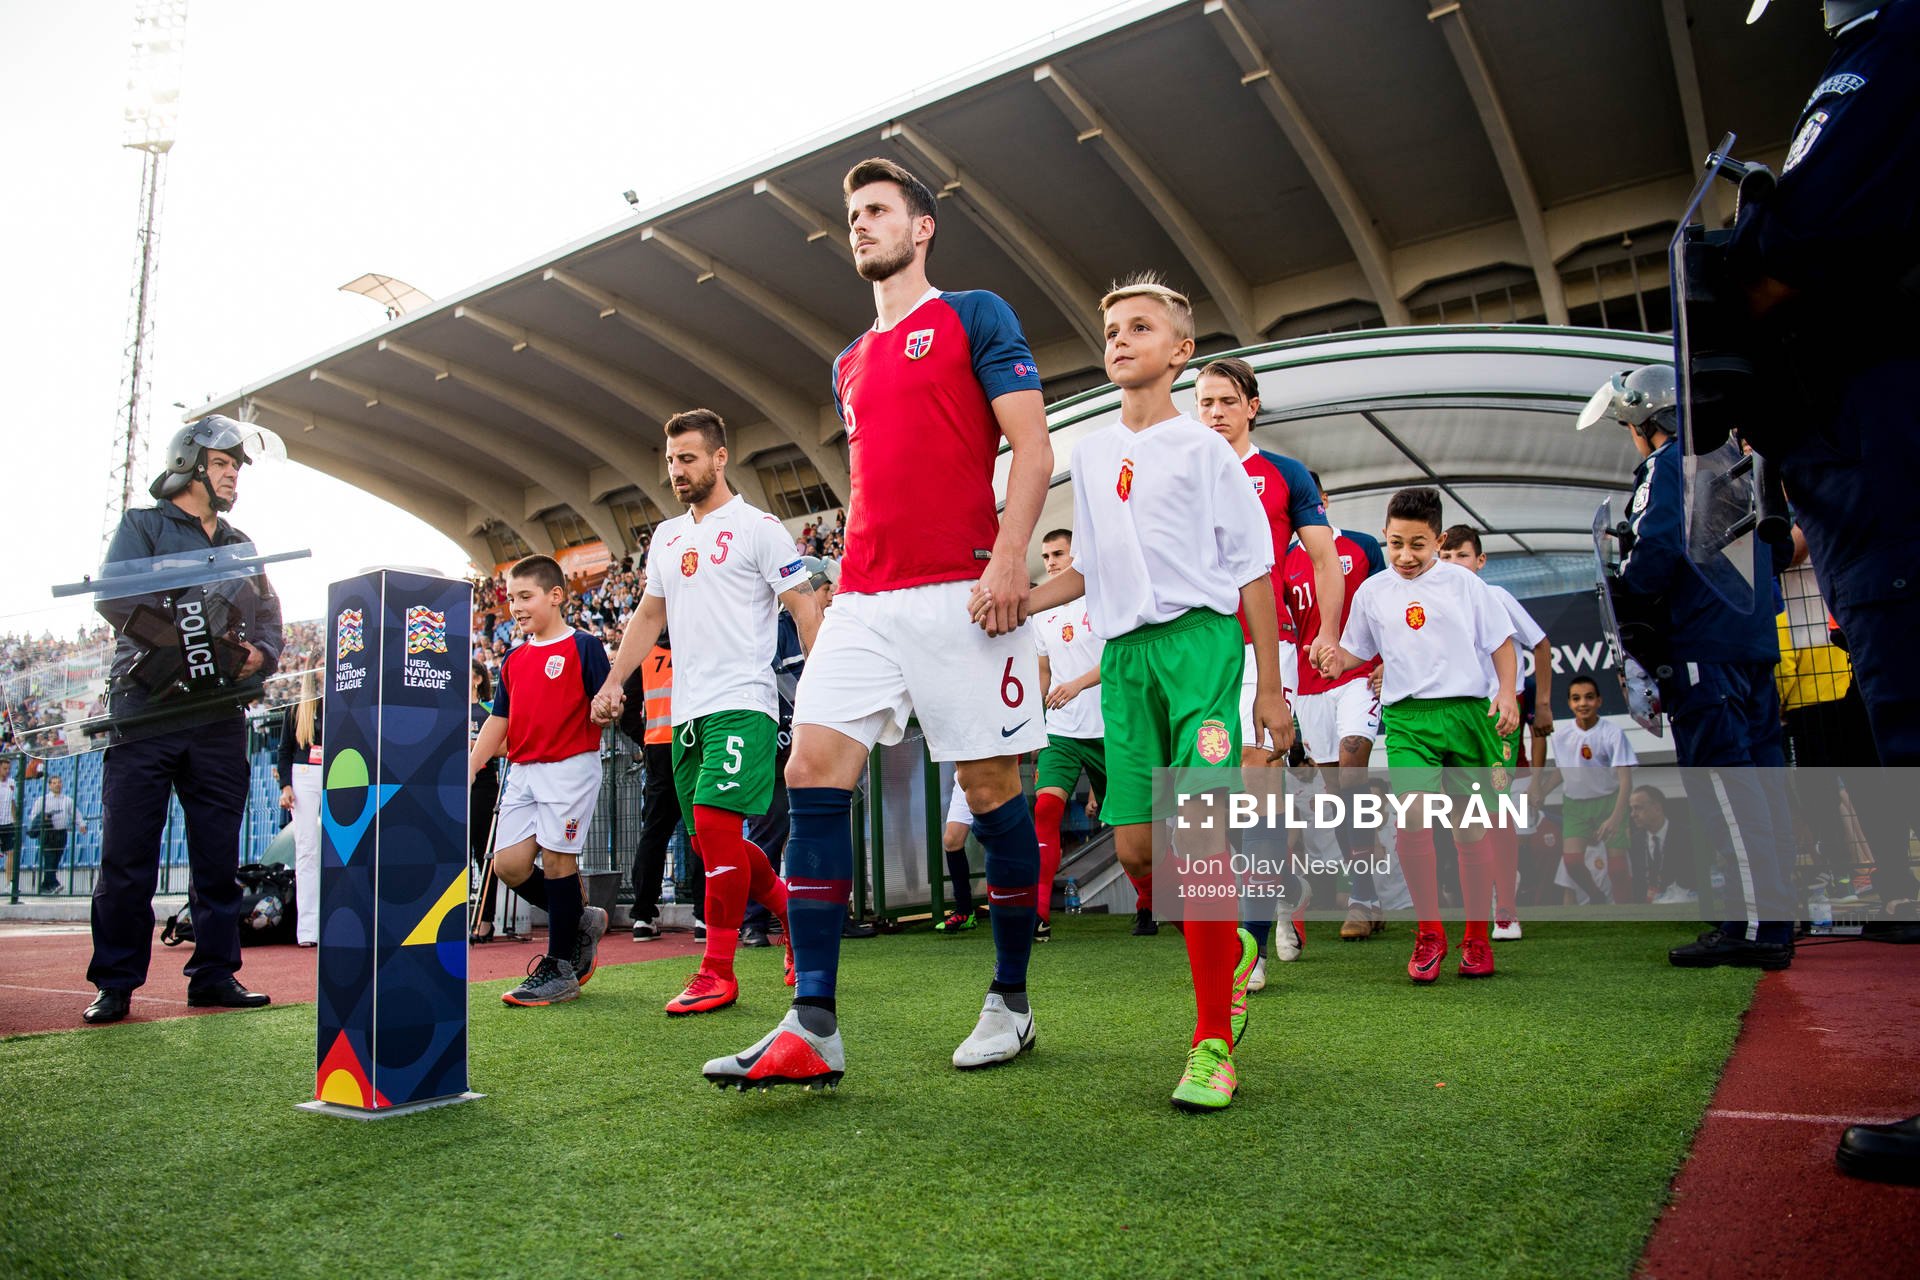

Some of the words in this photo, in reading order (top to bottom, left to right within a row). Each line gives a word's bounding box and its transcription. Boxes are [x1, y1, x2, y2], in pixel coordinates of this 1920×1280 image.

[844, 387, 857, 436] 6
[710, 531, 733, 565] 5
[1292, 582, 1312, 610] 21
[176, 601, 215, 679] POLICE
[338, 662, 352, 671] UEFA
[404, 667, 451, 680] NATIONS
[409, 659, 431, 669] UEFA
[336, 668, 366, 682] NATIONS
[336, 678, 363, 692] LEAGUE
[404, 677, 446, 690] LEAGUE
[1001, 656, 1024, 708] 6
[723, 735, 744, 774] 5
